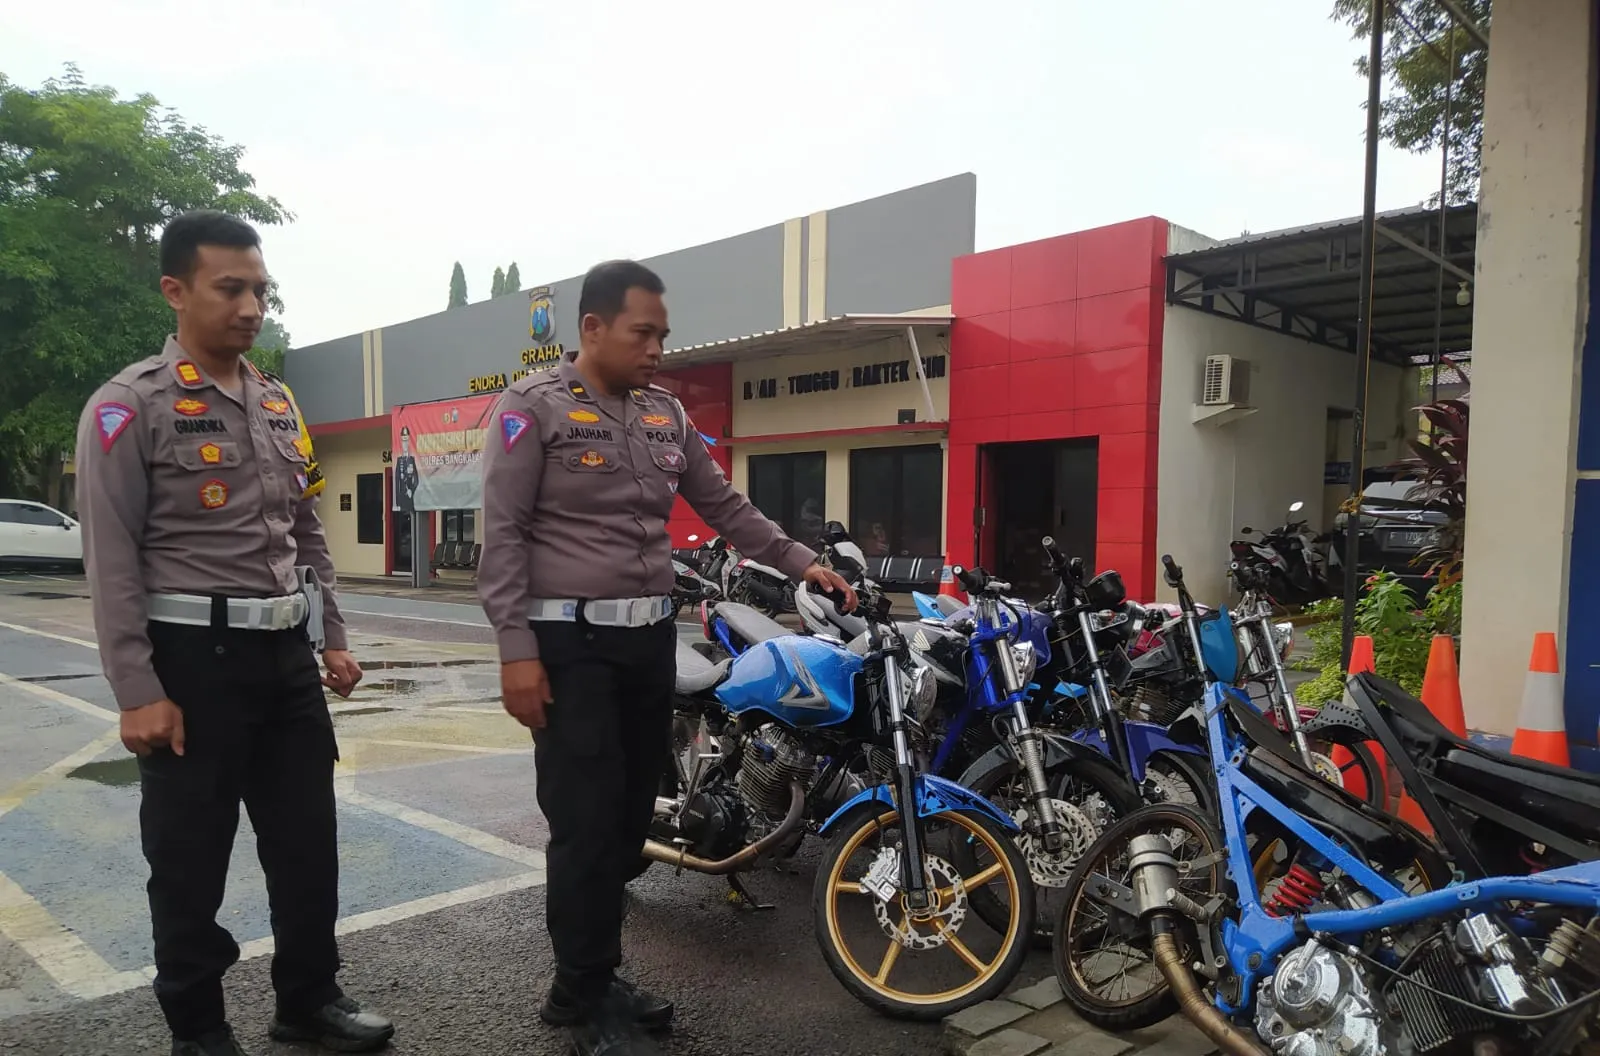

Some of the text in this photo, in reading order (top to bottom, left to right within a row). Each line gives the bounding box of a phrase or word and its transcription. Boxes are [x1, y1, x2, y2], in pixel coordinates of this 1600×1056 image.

[521, 344, 563, 365] GRAHA
[469, 373, 507, 392] ENDRA
[567, 427, 613, 441] JAUHARI
